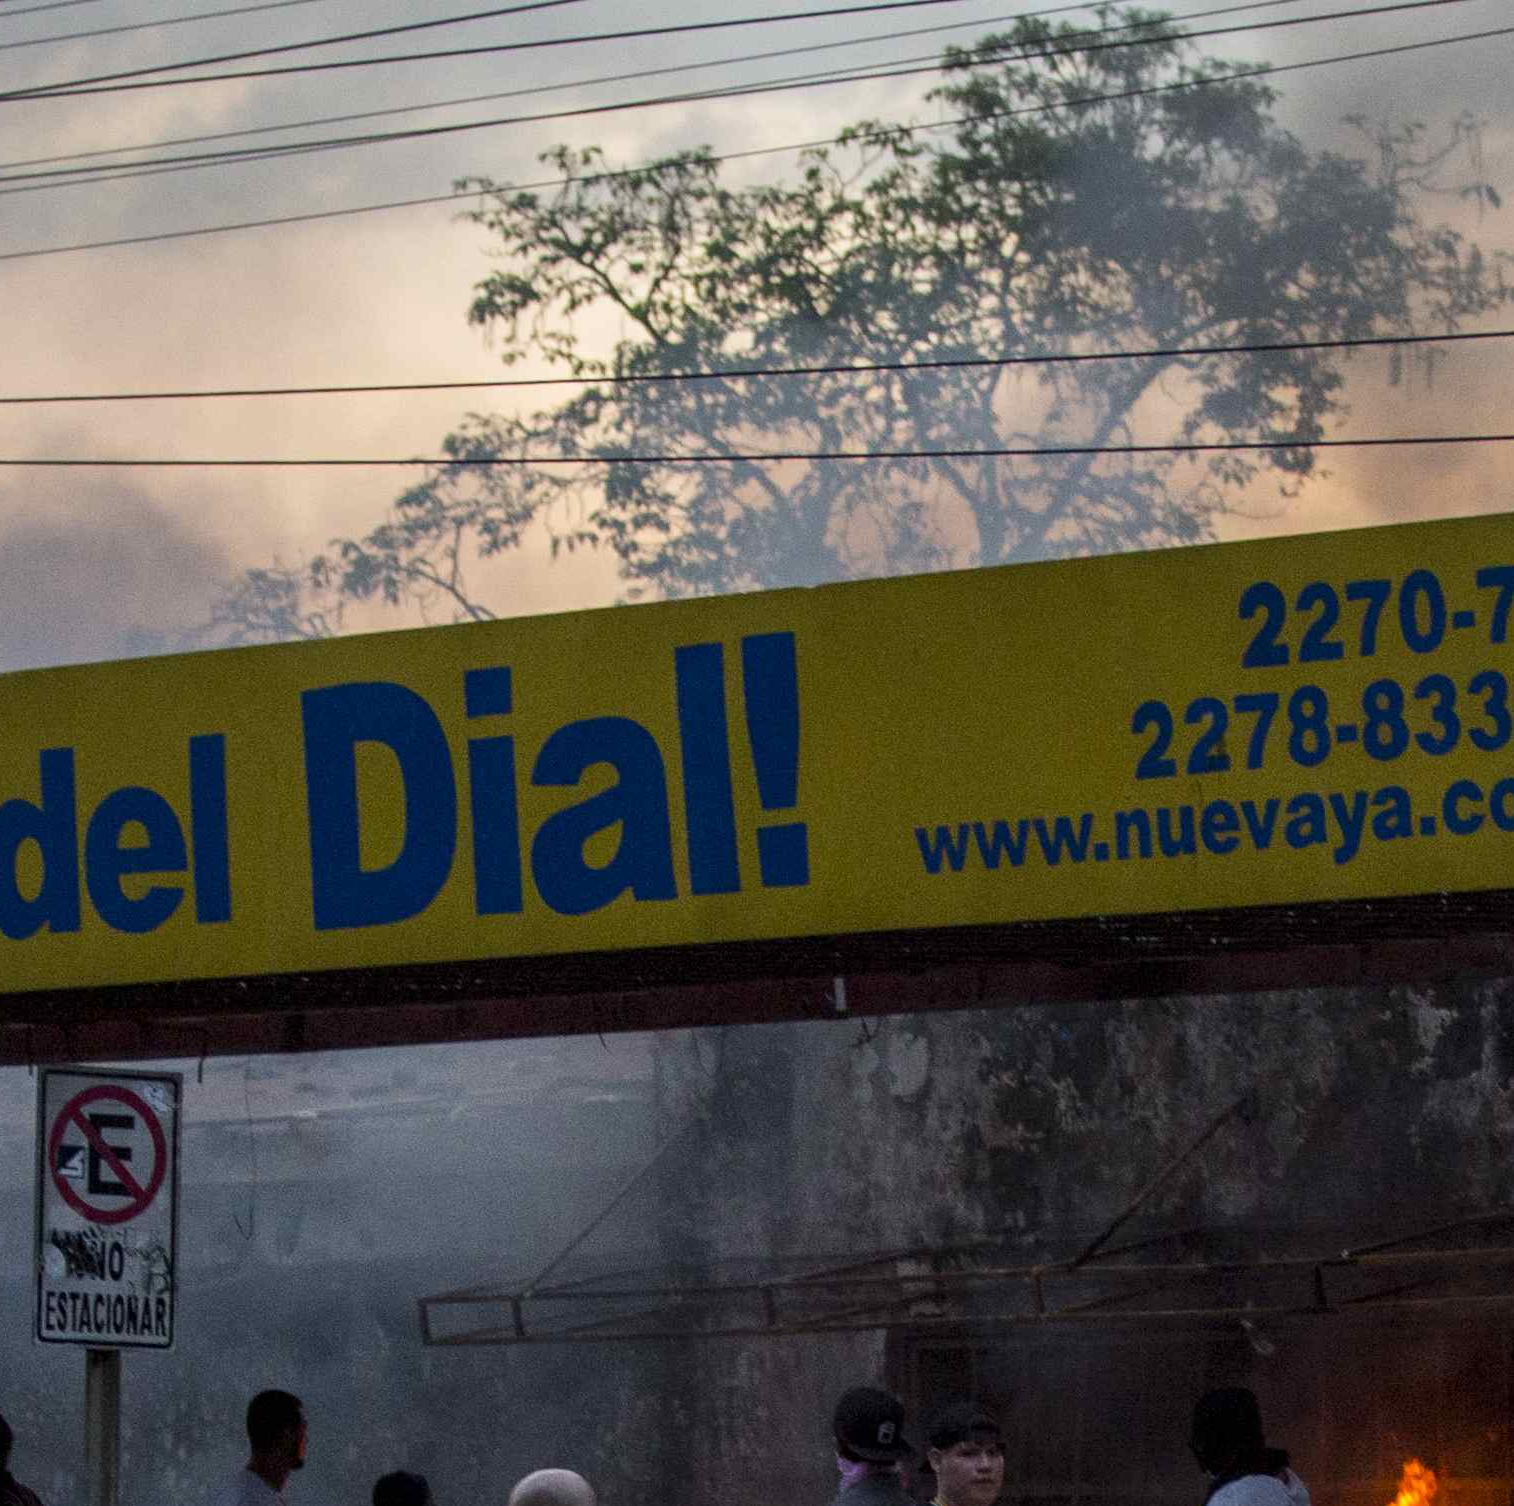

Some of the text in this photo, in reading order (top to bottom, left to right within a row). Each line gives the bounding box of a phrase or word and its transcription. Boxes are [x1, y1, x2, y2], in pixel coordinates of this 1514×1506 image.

[301, 632, 809, 930] Dial!
[88, 1113, 135, 1197] E
[45, 1290, 167, 1337] ESTACIONAR
